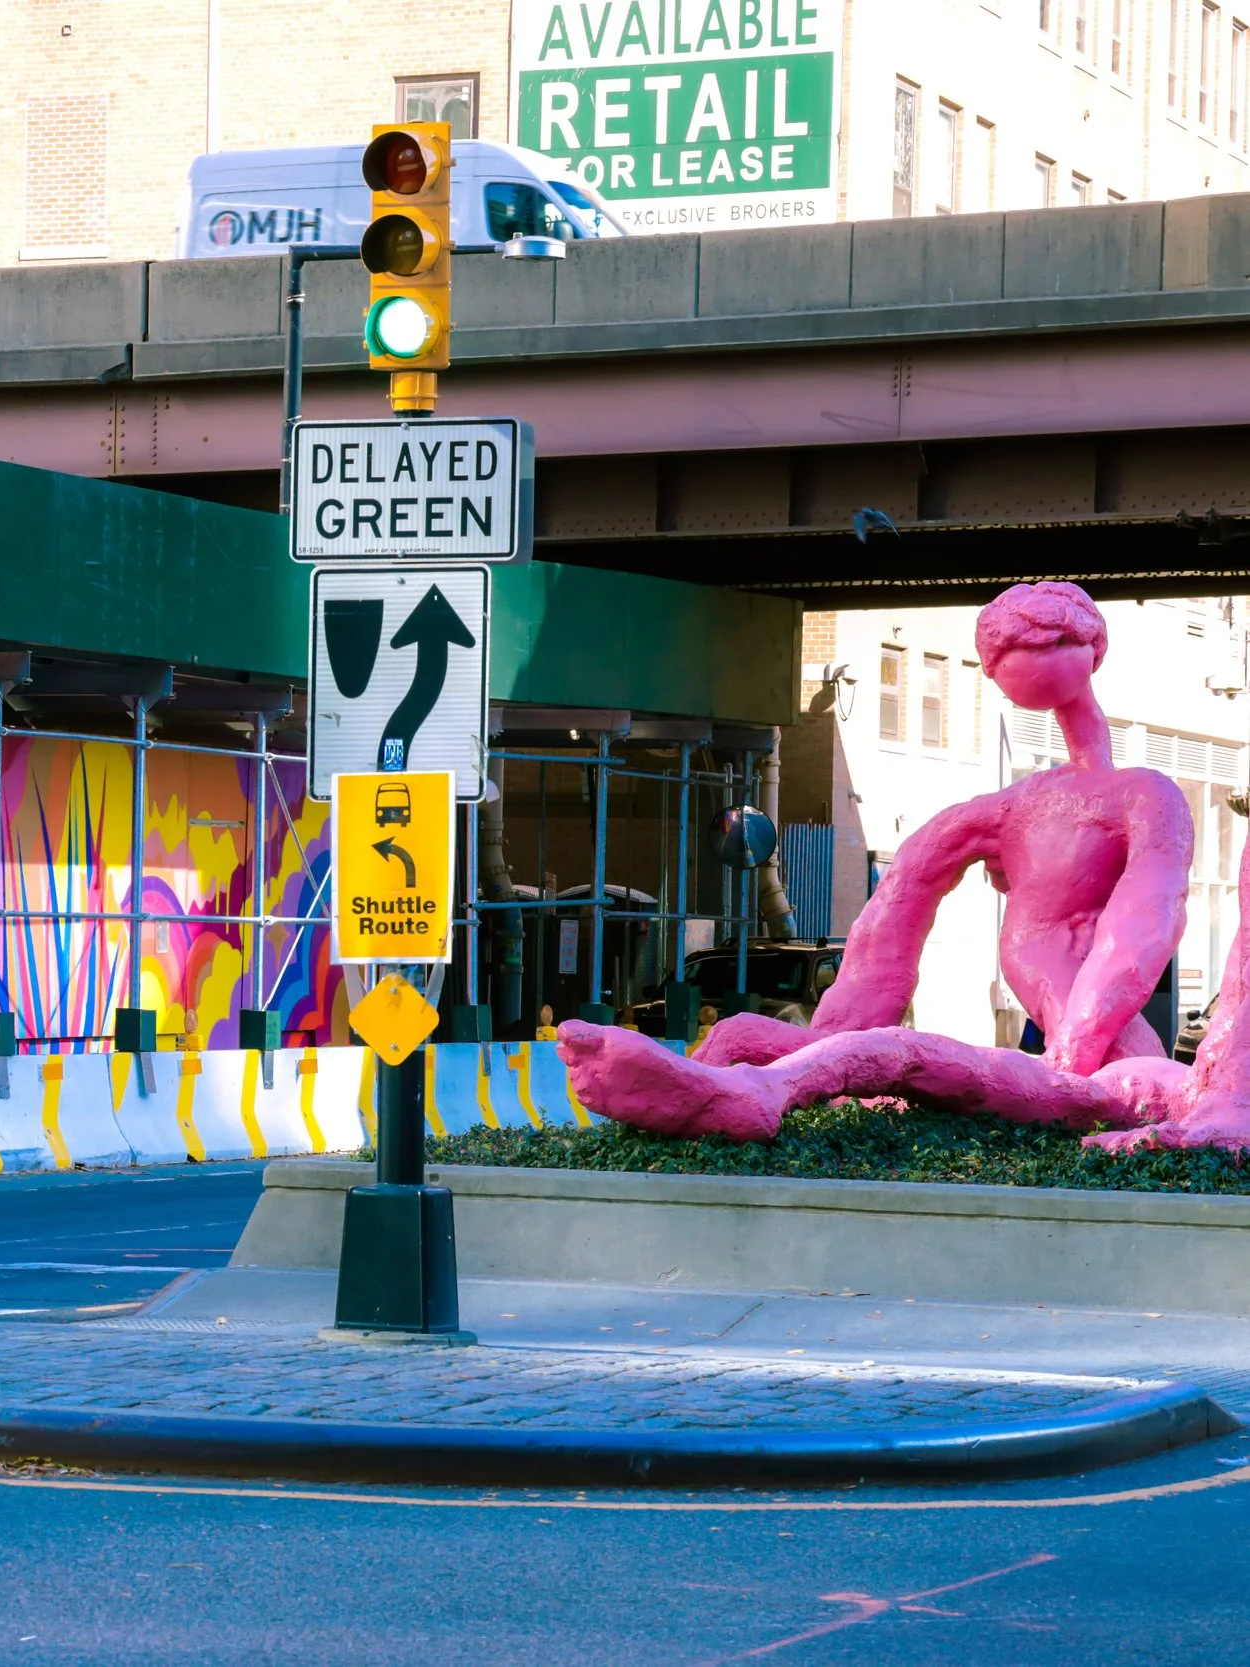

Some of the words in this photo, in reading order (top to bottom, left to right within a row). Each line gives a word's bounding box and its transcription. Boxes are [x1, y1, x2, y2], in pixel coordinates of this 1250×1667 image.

[538, 0, 818, 61] AVAILABLE
[540, 68, 809, 151] RETAIL
[652, 144, 795, 187] LEASE
[731, 201, 816, 221] BROKERS
[312, 440, 498, 484] DELAYED
[315, 496, 493, 540] GREEN
[298, 546, 324, 554] SR-1259
[352, 896, 436, 915] Shuttle
[359, 917, 429, 936] Route
